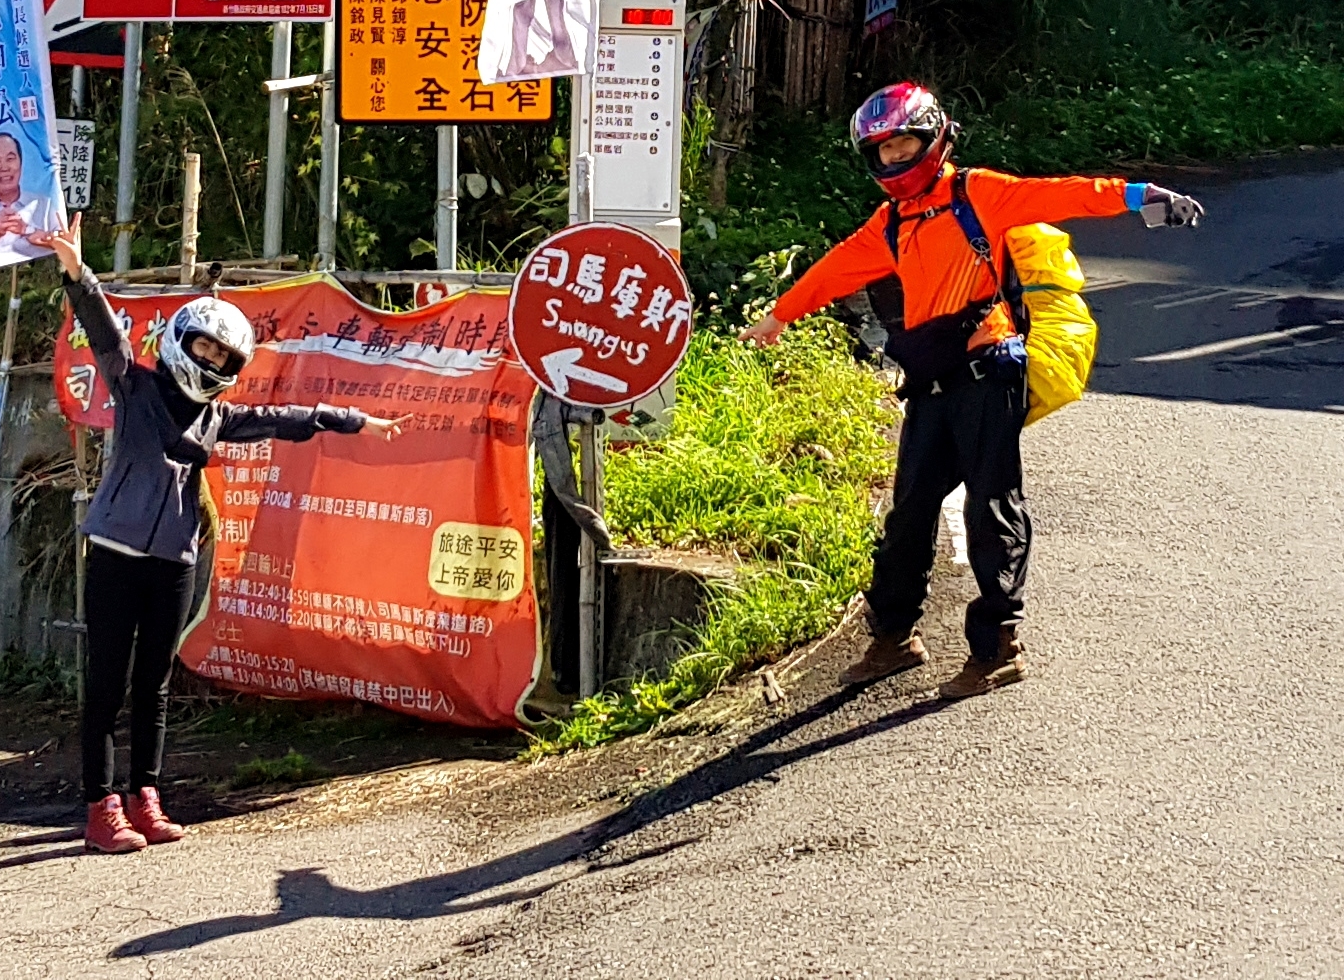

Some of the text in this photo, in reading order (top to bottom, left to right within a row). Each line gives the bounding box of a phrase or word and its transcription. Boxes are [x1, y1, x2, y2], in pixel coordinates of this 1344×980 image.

[369, 57, 387, 113] 關心您
[529, 248, 691, 345] 司馬庫斯
[542, 298, 649, 366] Smangus
[439, 533, 519, 562] 旅途平安
[435, 566, 516, 591] 上帝愛你
